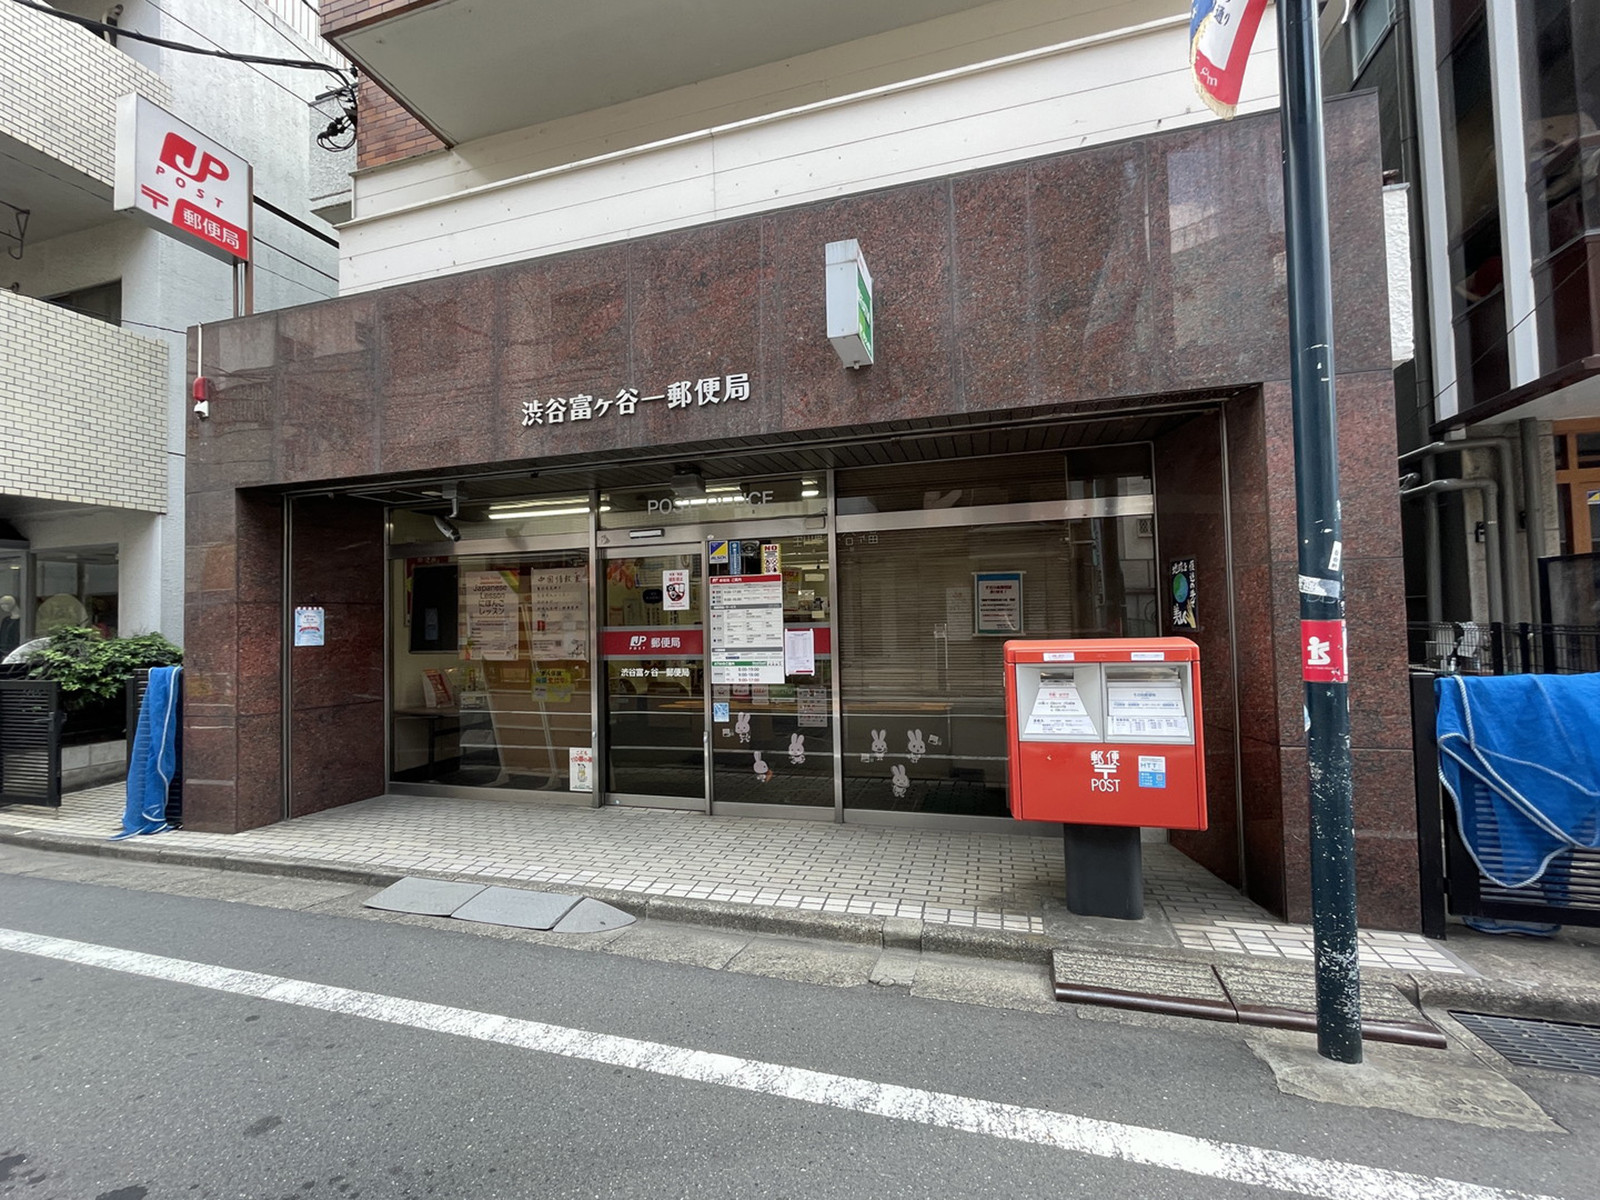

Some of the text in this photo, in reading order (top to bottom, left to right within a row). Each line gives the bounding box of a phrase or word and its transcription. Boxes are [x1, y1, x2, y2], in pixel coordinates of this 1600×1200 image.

[156, 165, 224, 208] POST
[183, 207, 239, 249] 郵便局
[647, 497, 696, 515] POST
[473, 584, 508, 592] Japanese
[651, 637, 681, 648] 郵便局
[1090, 750, 1120, 766] 郵便
[1090, 778, 1121, 793] POST
